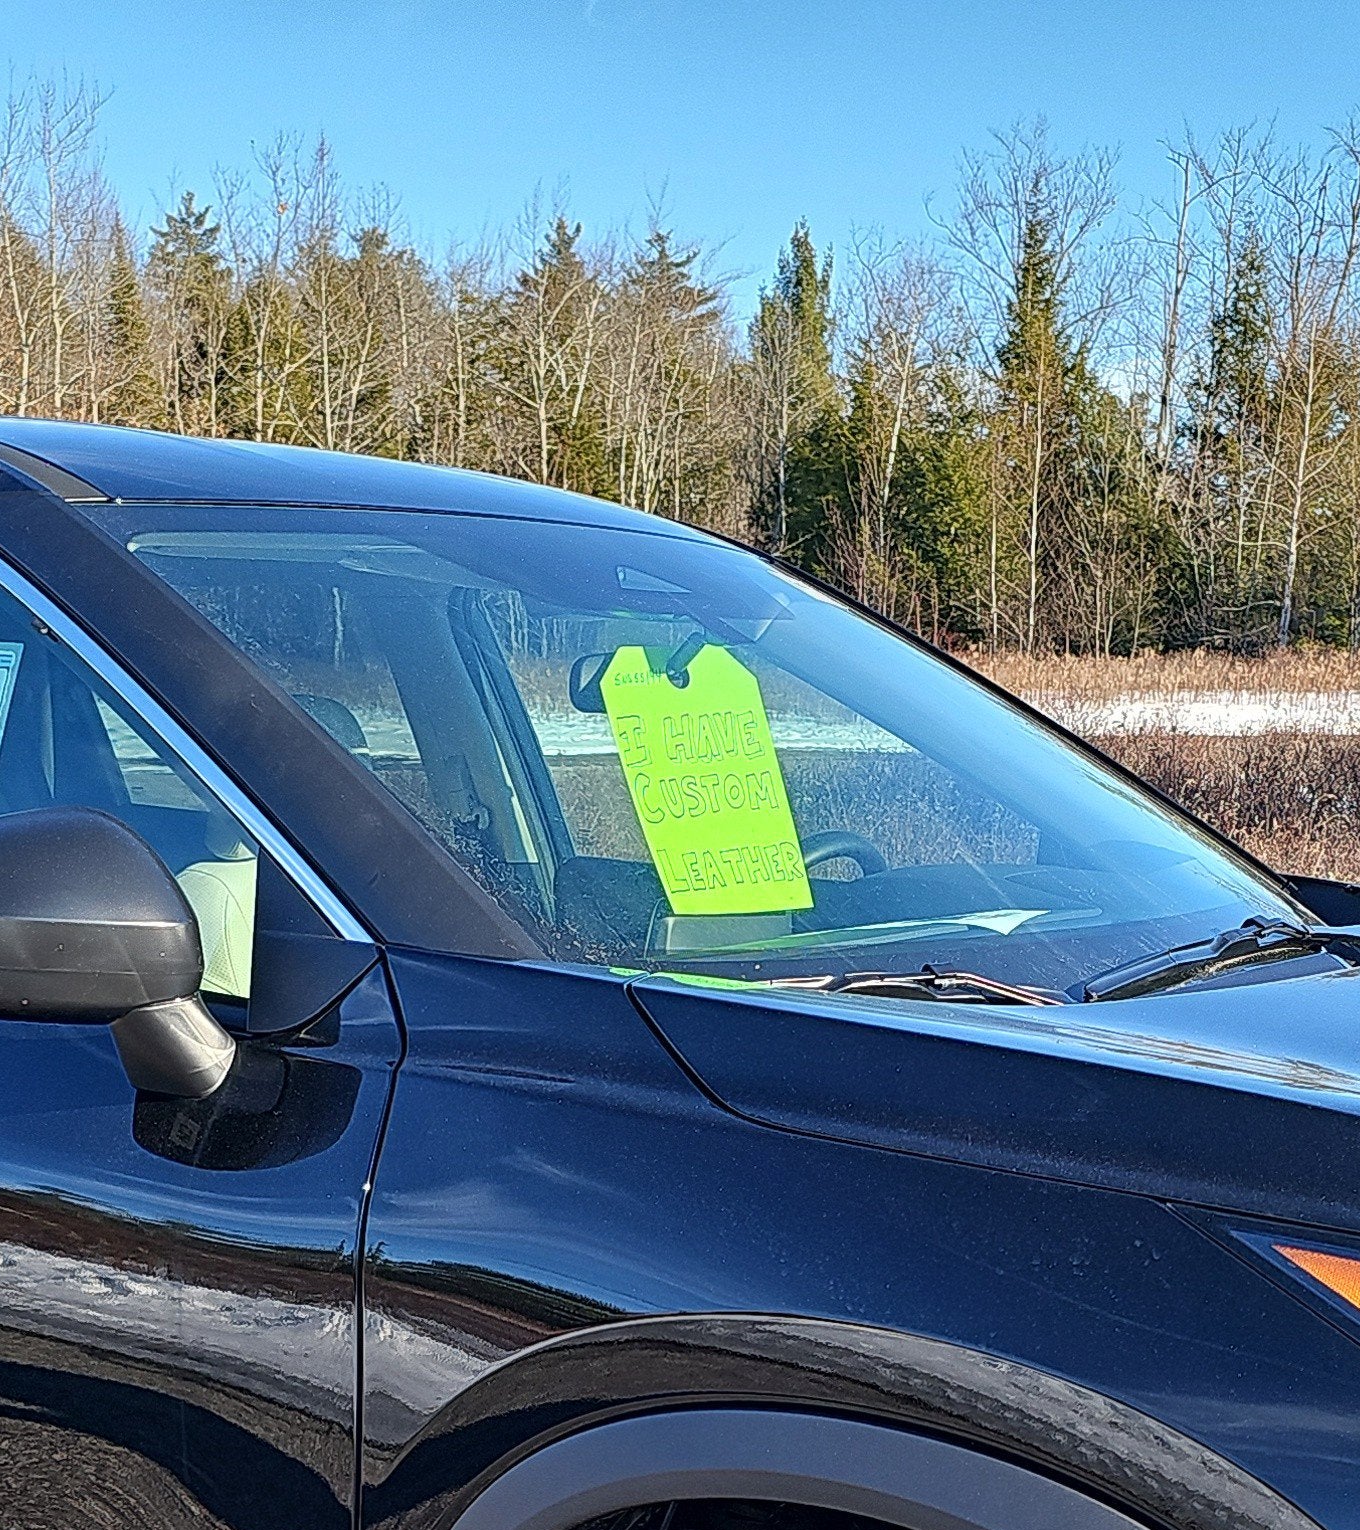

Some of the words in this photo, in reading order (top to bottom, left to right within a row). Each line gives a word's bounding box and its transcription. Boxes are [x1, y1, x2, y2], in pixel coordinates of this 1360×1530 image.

[617, 714, 652, 768] I
[663, 710, 766, 765] HAVE
[634, 771, 779, 824] CUSTOM
[657, 842, 804, 894] LEATHER
